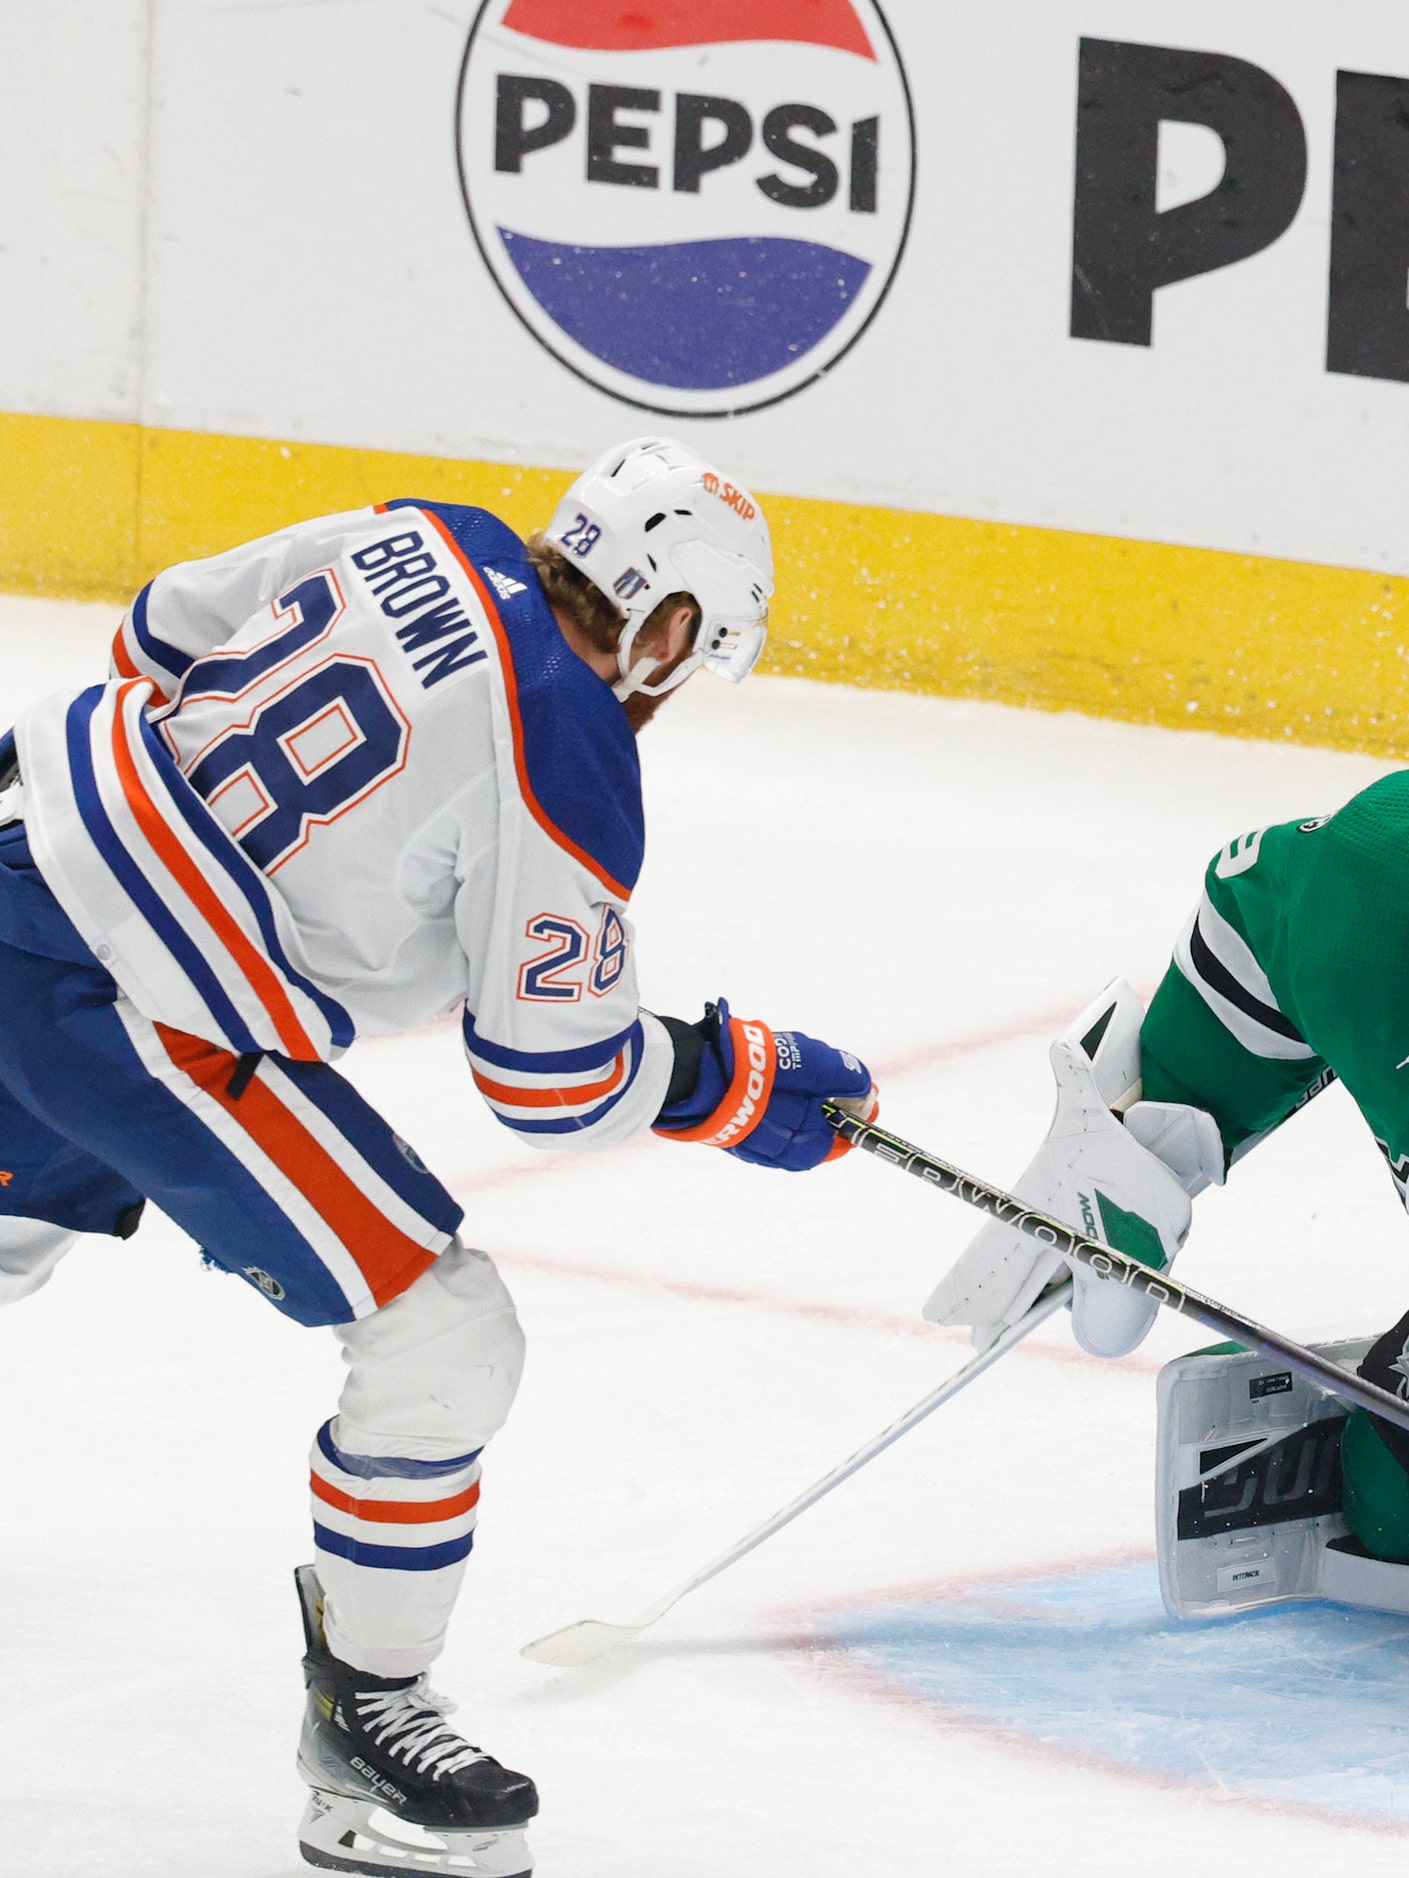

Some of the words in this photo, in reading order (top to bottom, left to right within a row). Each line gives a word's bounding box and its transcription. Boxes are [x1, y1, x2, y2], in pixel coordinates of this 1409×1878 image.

[494, 72, 880, 215] PEPSI
[560, 512, 603, 559] 28
[719, 483, 756, 521] SKIP
[350, 530, 488, 691] BROWN
[147, 567, 412, 878] 28
[516, 901, 630, 1003] 28
